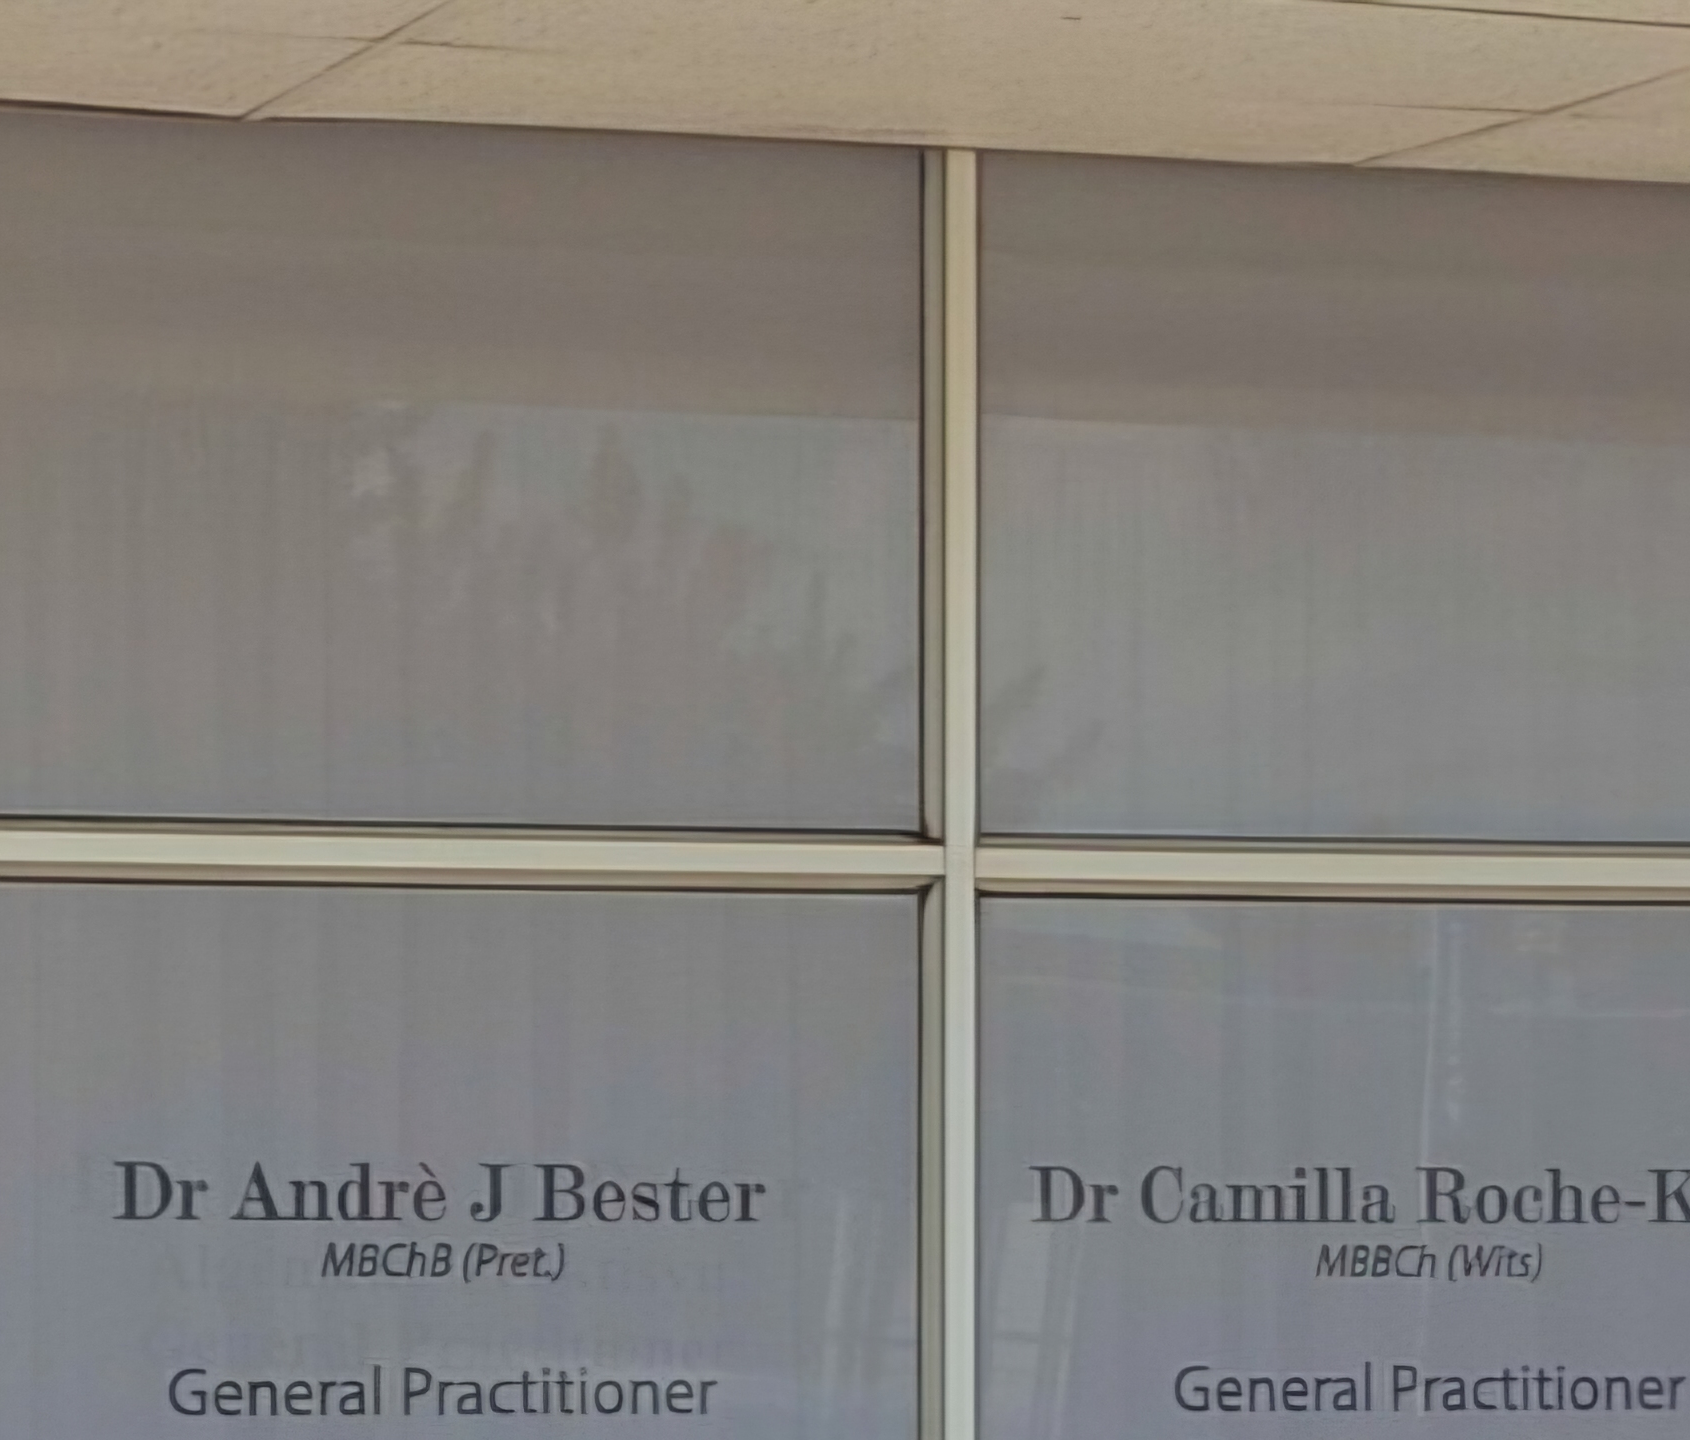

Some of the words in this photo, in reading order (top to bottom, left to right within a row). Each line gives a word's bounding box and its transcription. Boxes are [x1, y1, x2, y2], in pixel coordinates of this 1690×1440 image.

[112, 1160, 209, 1222] Dr
[230, 1160, 447, 1223] Andrè
[469, 1163, 512, 1223] J
[534, 1163, 768, 1223] Bester
[1029, 1165, 1121, 1225] Dr
[1141, 1165, 1398, 1225] Camilla
[321, 1241, 453, 1278] MBChB
[1315, 1243, 1438, 1279] MBBCh
[1447, 1242, 1544, 1284] (Wits)
[168, 1364, 383, 1417] General
[404, 1365, 718, 1416] Practitioner
[1173, 1361, 1375, 1414] General
[1392, 1364, 1688, 1413] Practitioner
